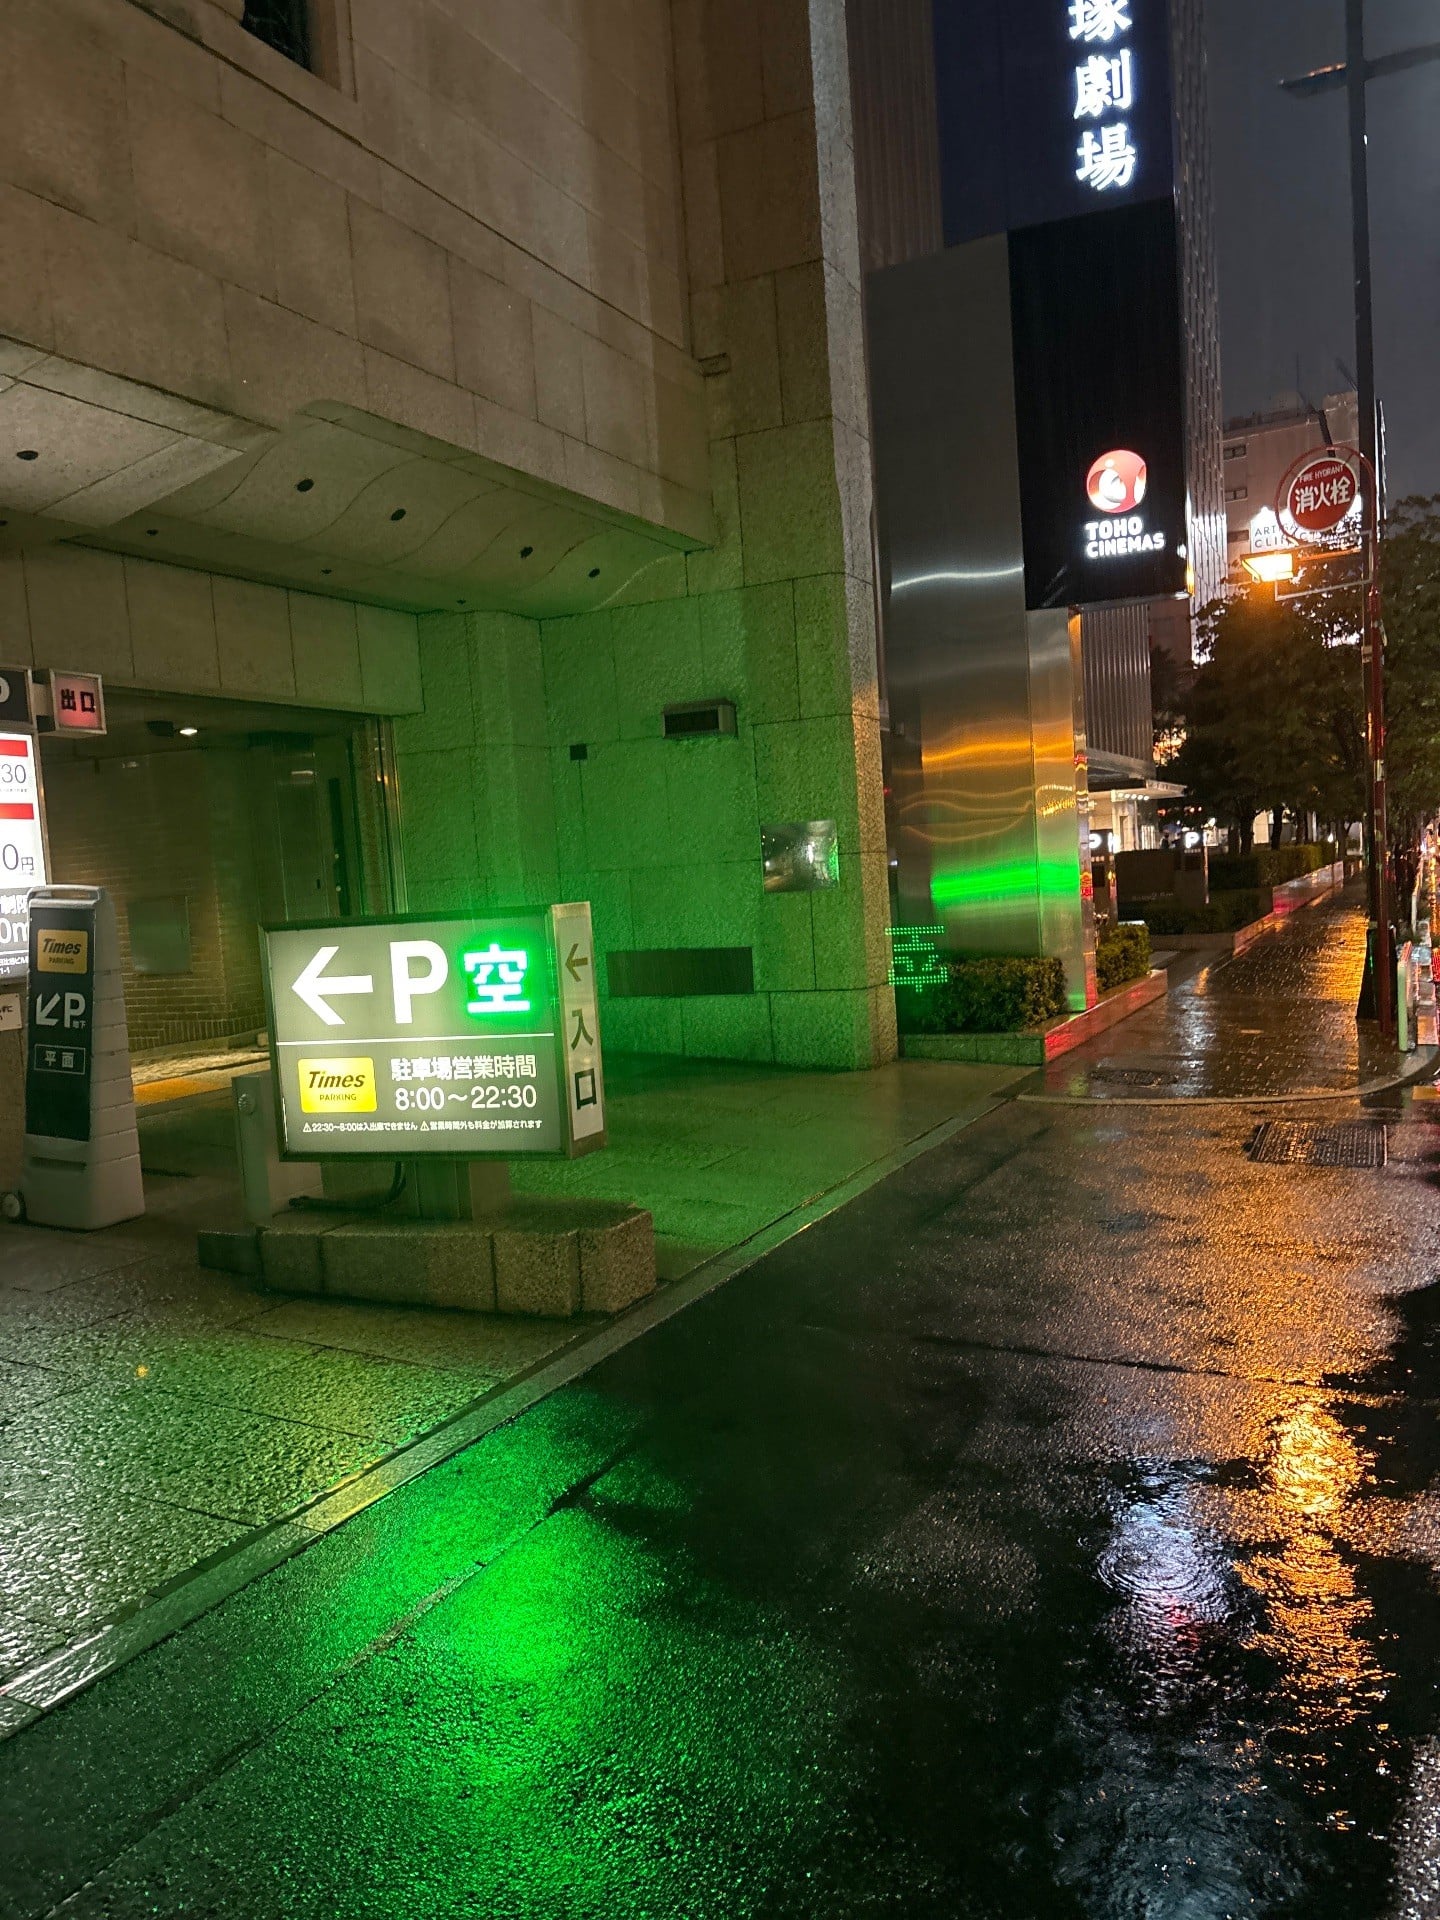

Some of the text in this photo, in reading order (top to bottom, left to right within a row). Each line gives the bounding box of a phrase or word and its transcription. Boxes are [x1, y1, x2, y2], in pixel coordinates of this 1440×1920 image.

[1068, 0, 1136, 191] 塚劇場
[1299, 465, 1345, 484] FIRE HYDRANT
[1295, 476, 1351, 515] 消火栓
[1085, 517, 1142, 540] TOHO
[1086, 533, 1165, 558] CINEMAS
[60, 688, 96, 714] 出口
[42, 937, 82, 956] Times
[49, 956, 75, 966] PARKING
[390, 940, 532, 1024] P 空
[64, 992, 86, 1028] P
[44, 1050, 75, 1069] 平面
[391, 1054, 537, 1081] 駐車場営業時間
[571, 1009, 598, 1110] 入口
[307, 1071, 366, 1089] Times
[319, 1093, 358, 1102] PARKING
